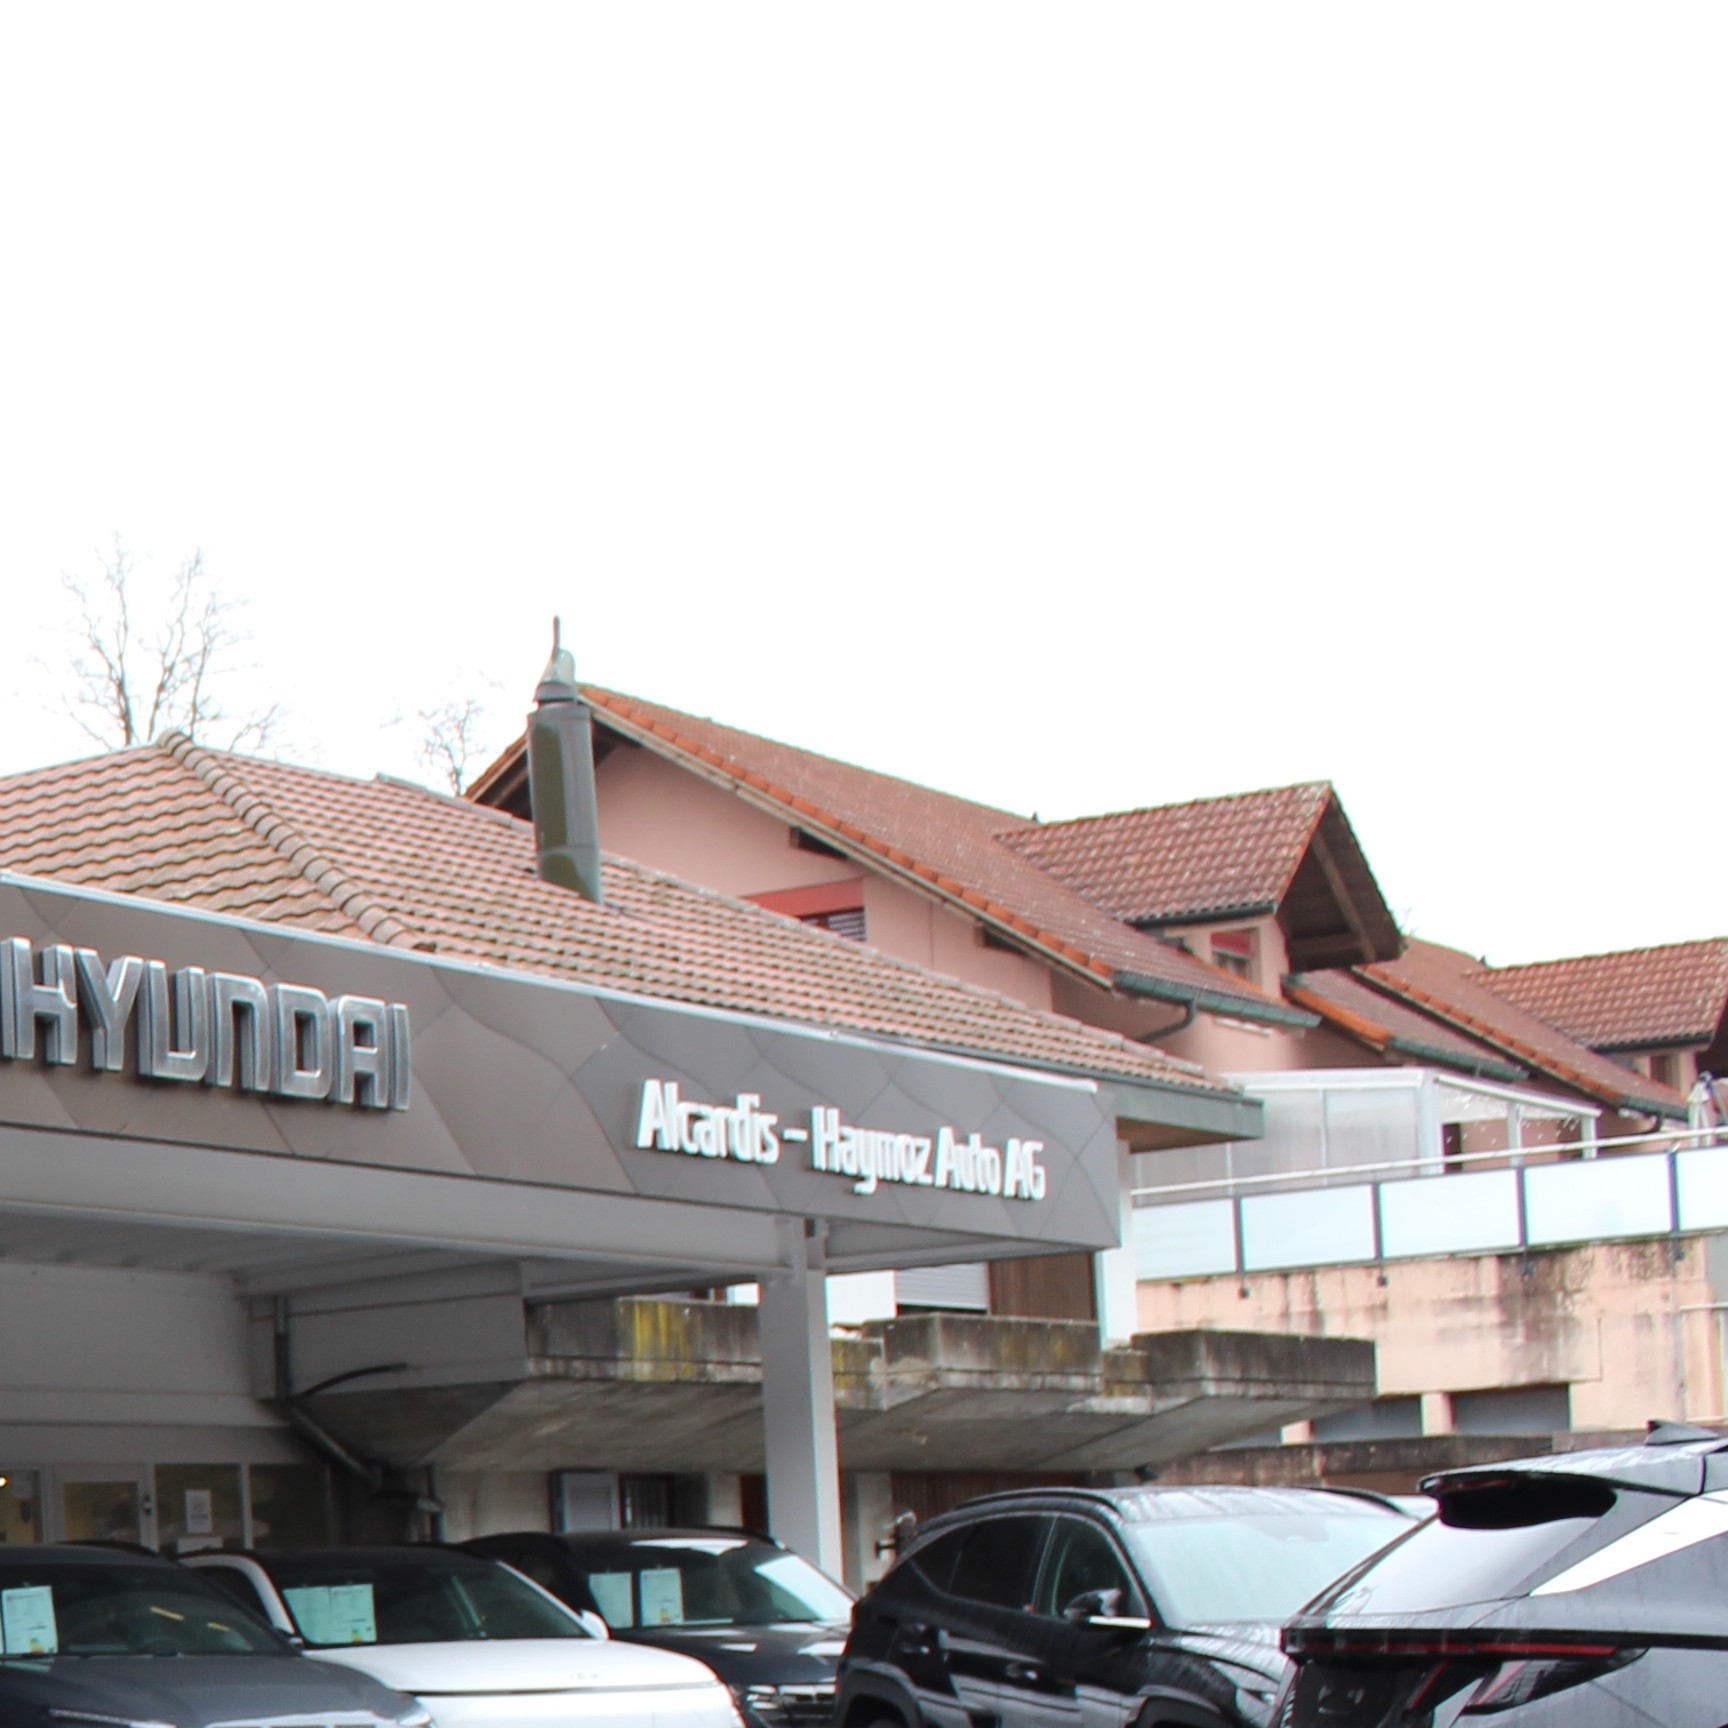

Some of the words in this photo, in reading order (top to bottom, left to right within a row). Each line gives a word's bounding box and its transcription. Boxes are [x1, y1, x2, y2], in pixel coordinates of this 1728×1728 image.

[636, 1078, 780, 1165] Alcardis
[811, 1106, 934, 1195] Haymoz
[935, 1126, 1001, 1195] Auto
[1003, 1137, 1045, 1200] AG
